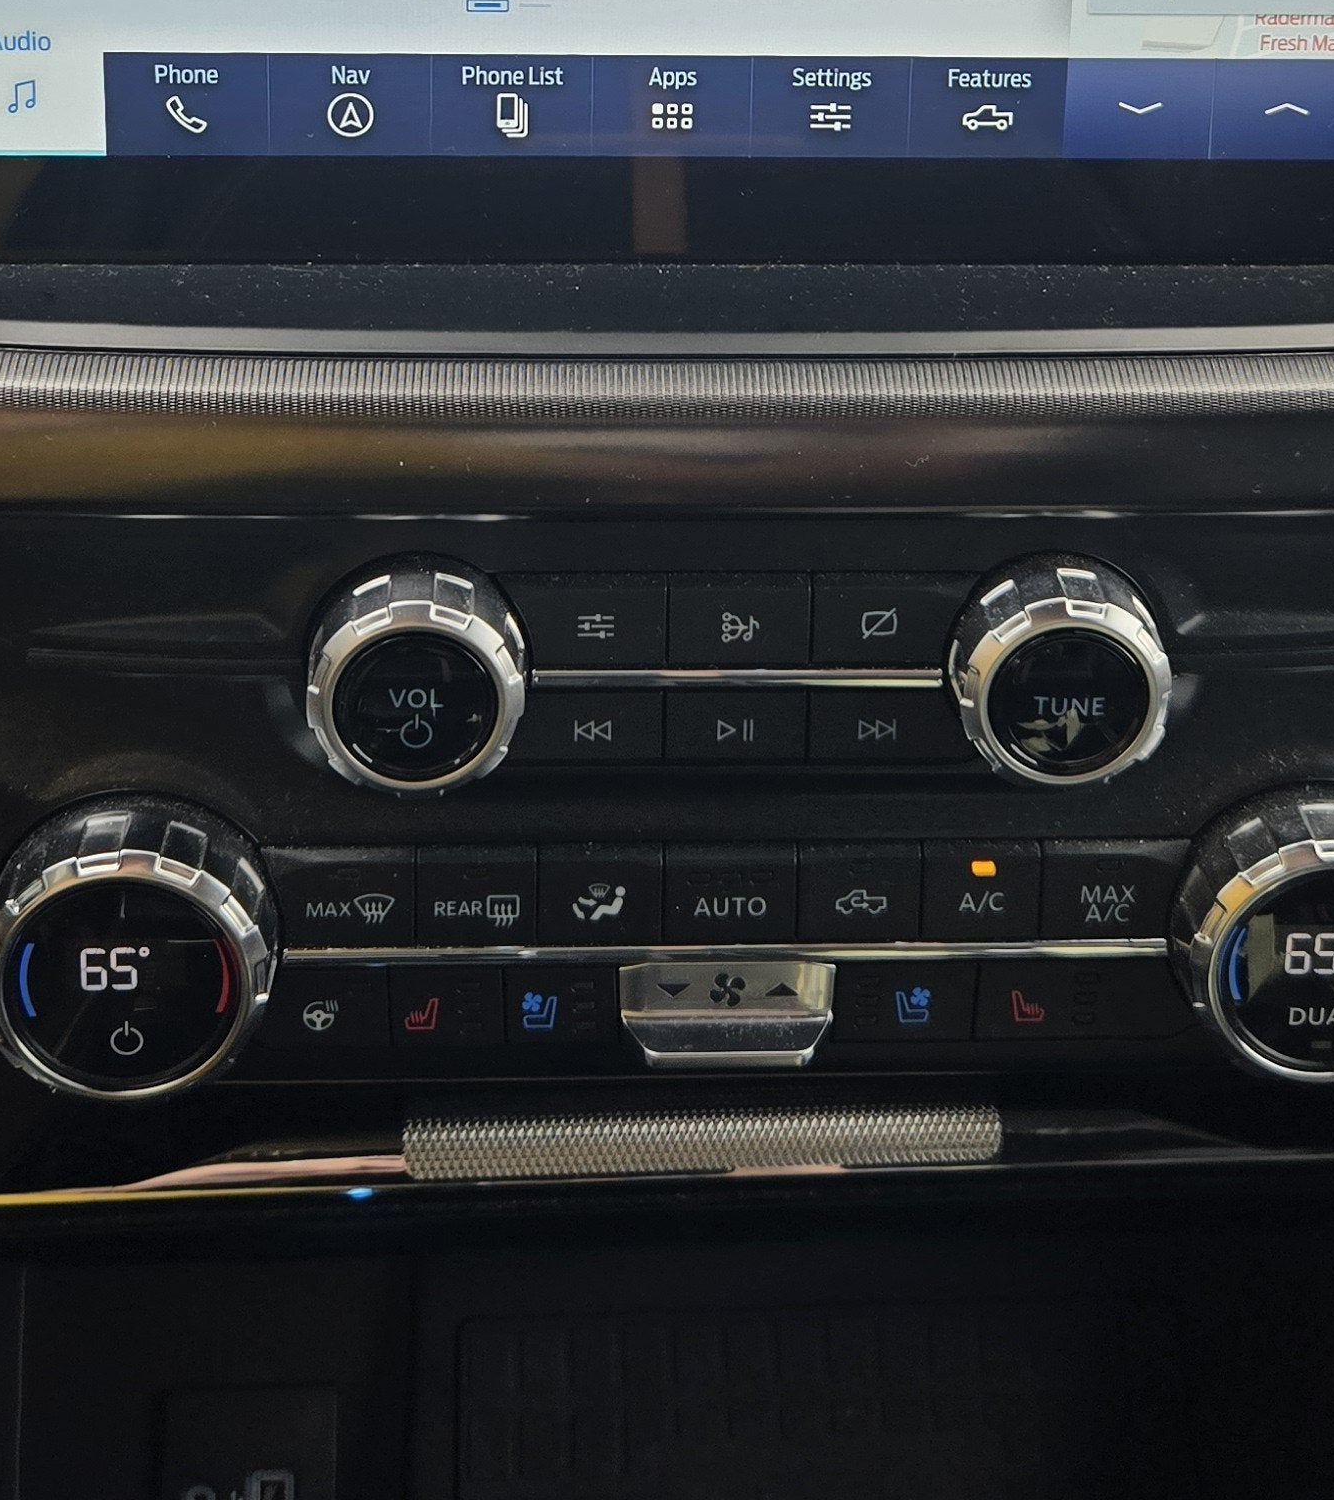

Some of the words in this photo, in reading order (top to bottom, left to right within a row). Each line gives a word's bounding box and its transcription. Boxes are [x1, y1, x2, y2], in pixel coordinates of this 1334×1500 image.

[1260, 32, 1312, 52] Fresh
[154, 64, 219, 86] Phone
[330, 66, 371, 86] Nav
[461, 66, 520, 87] Phone
[523, 66, 564, 88] List
[649, 67, 698, 92] Apps
[791, 67, 872, 91] Settings
[947, 68, 1033, 89] Features
[389, 689, 444, 708] VOL
[1034, 697, 1105, 716] TUNE
[959, 892, 1005, 912] A/C
[1081, 885, 1136, 903] MAX
[306, 902, 351, 918] MAX
[434, 901, 483, 918] REAR
[694, 897, 767, 918] AUTO
[1085, 902, 1129, 923] A/C
